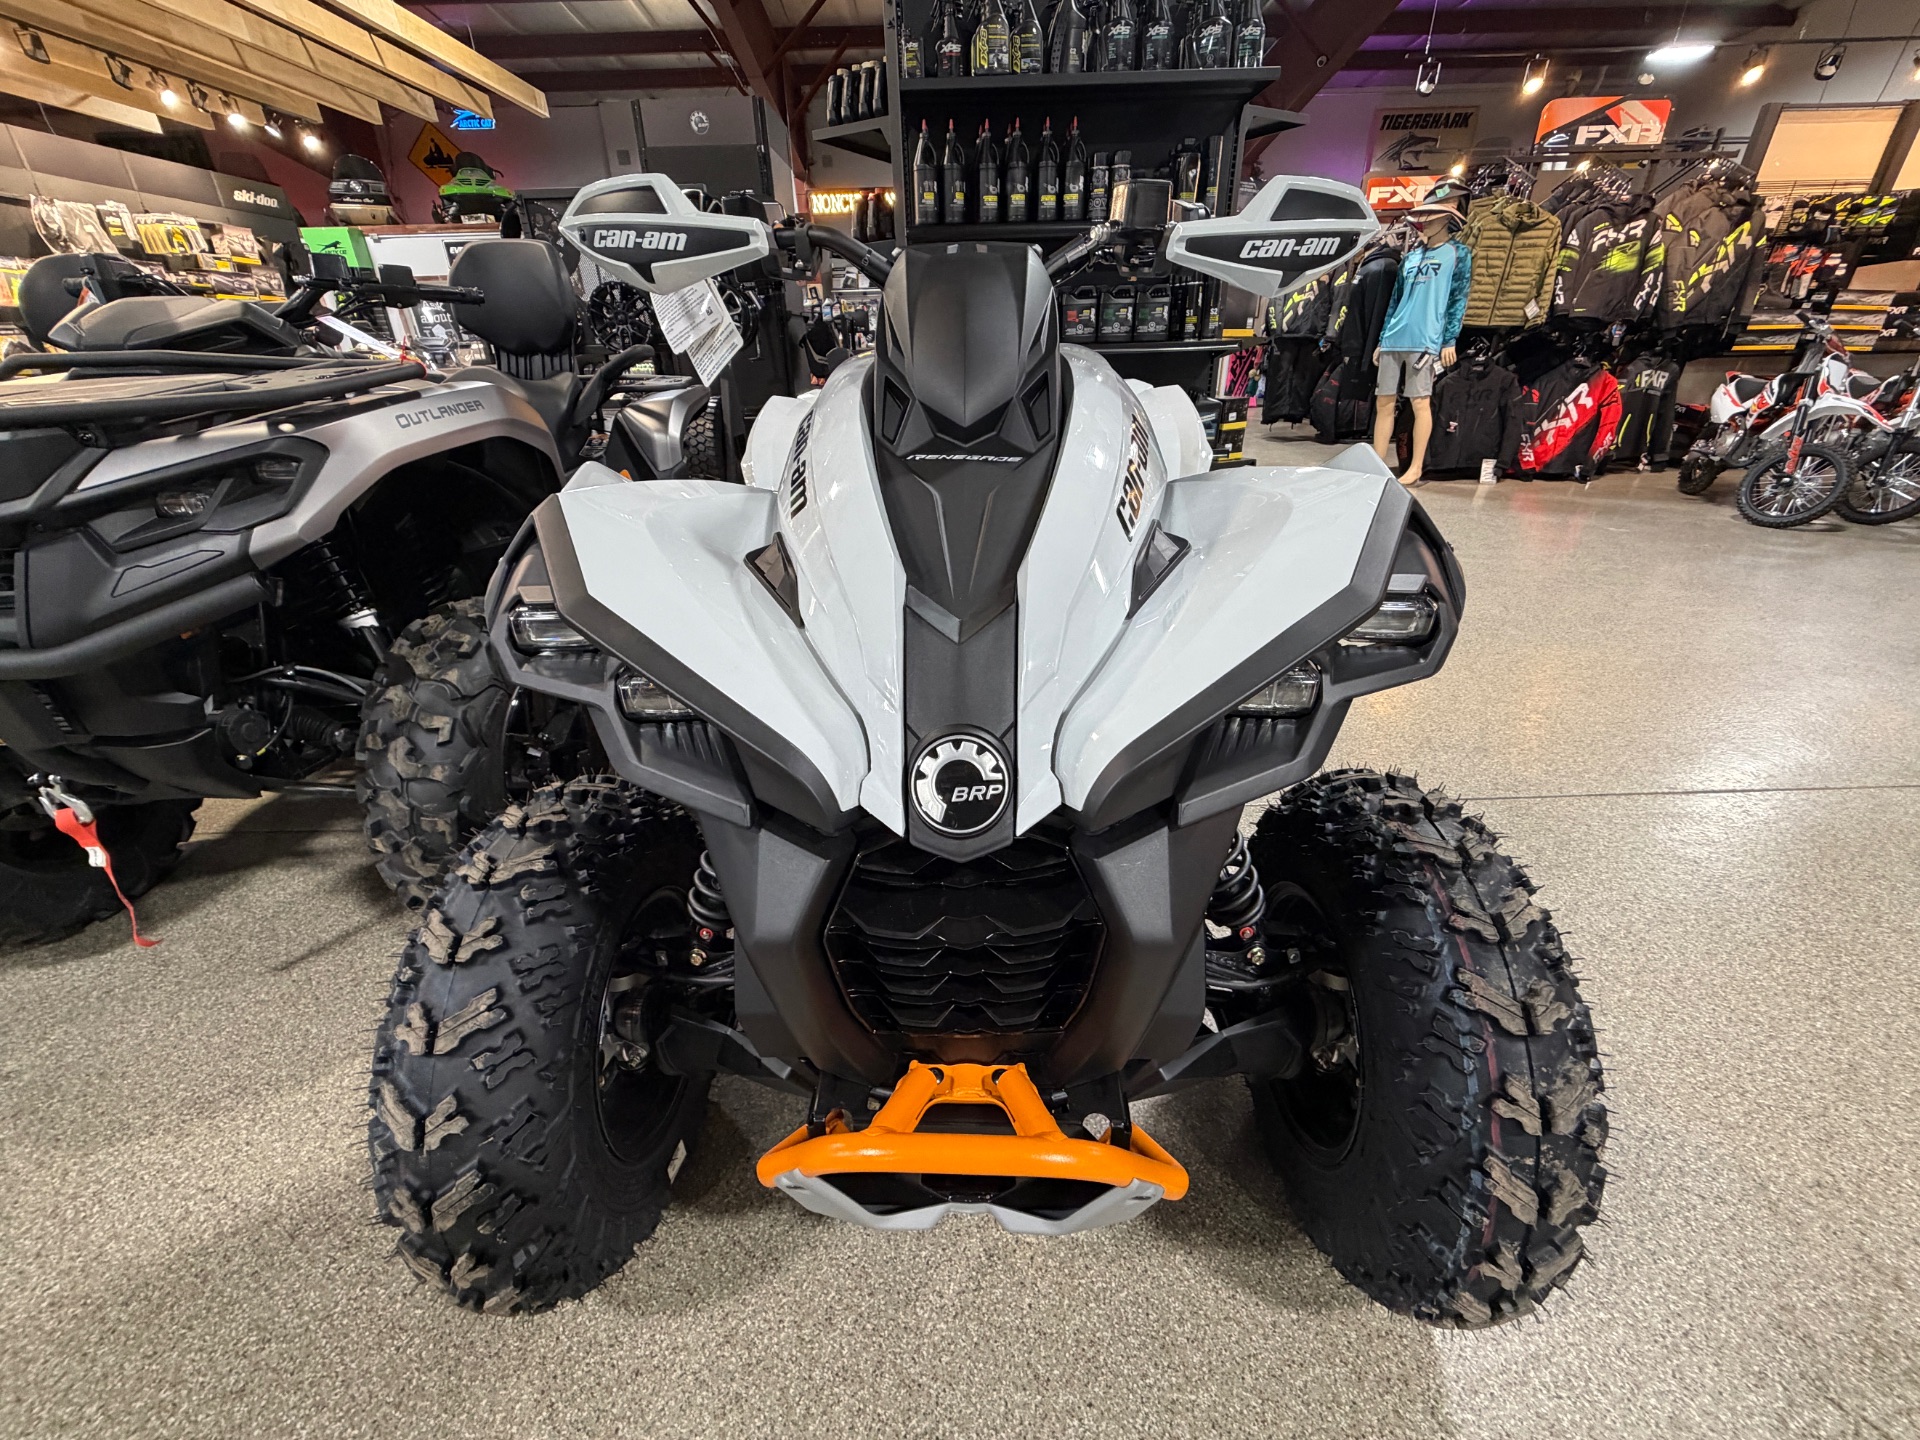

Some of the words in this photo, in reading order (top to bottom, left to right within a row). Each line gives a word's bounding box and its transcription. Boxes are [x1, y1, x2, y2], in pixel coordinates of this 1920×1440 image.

[1108, 25, 1131, 36] XPS
[1146, 25, 1169, 36] XPS
[1239, 25, 1261, 36] XPS
[941, 44, 962, 53] XPS
[1380, 112, 1473, 131] TIGERSHARK
[1575, 124, 1665, 145] FXR
[233, 189, 279, 208] ski-doo
[593, 229, 688, 252] can-am
[1239, 237, 1341, 259] can-am
[1406, 262, 1442, 280] FXR
[1641, 371, 1670, 389] FXR
[395, 400, 485, 429] OUTLANDER
[906, 454, 1023, 463] RENEGADE
[951, 784, 1003, 802] BRP
